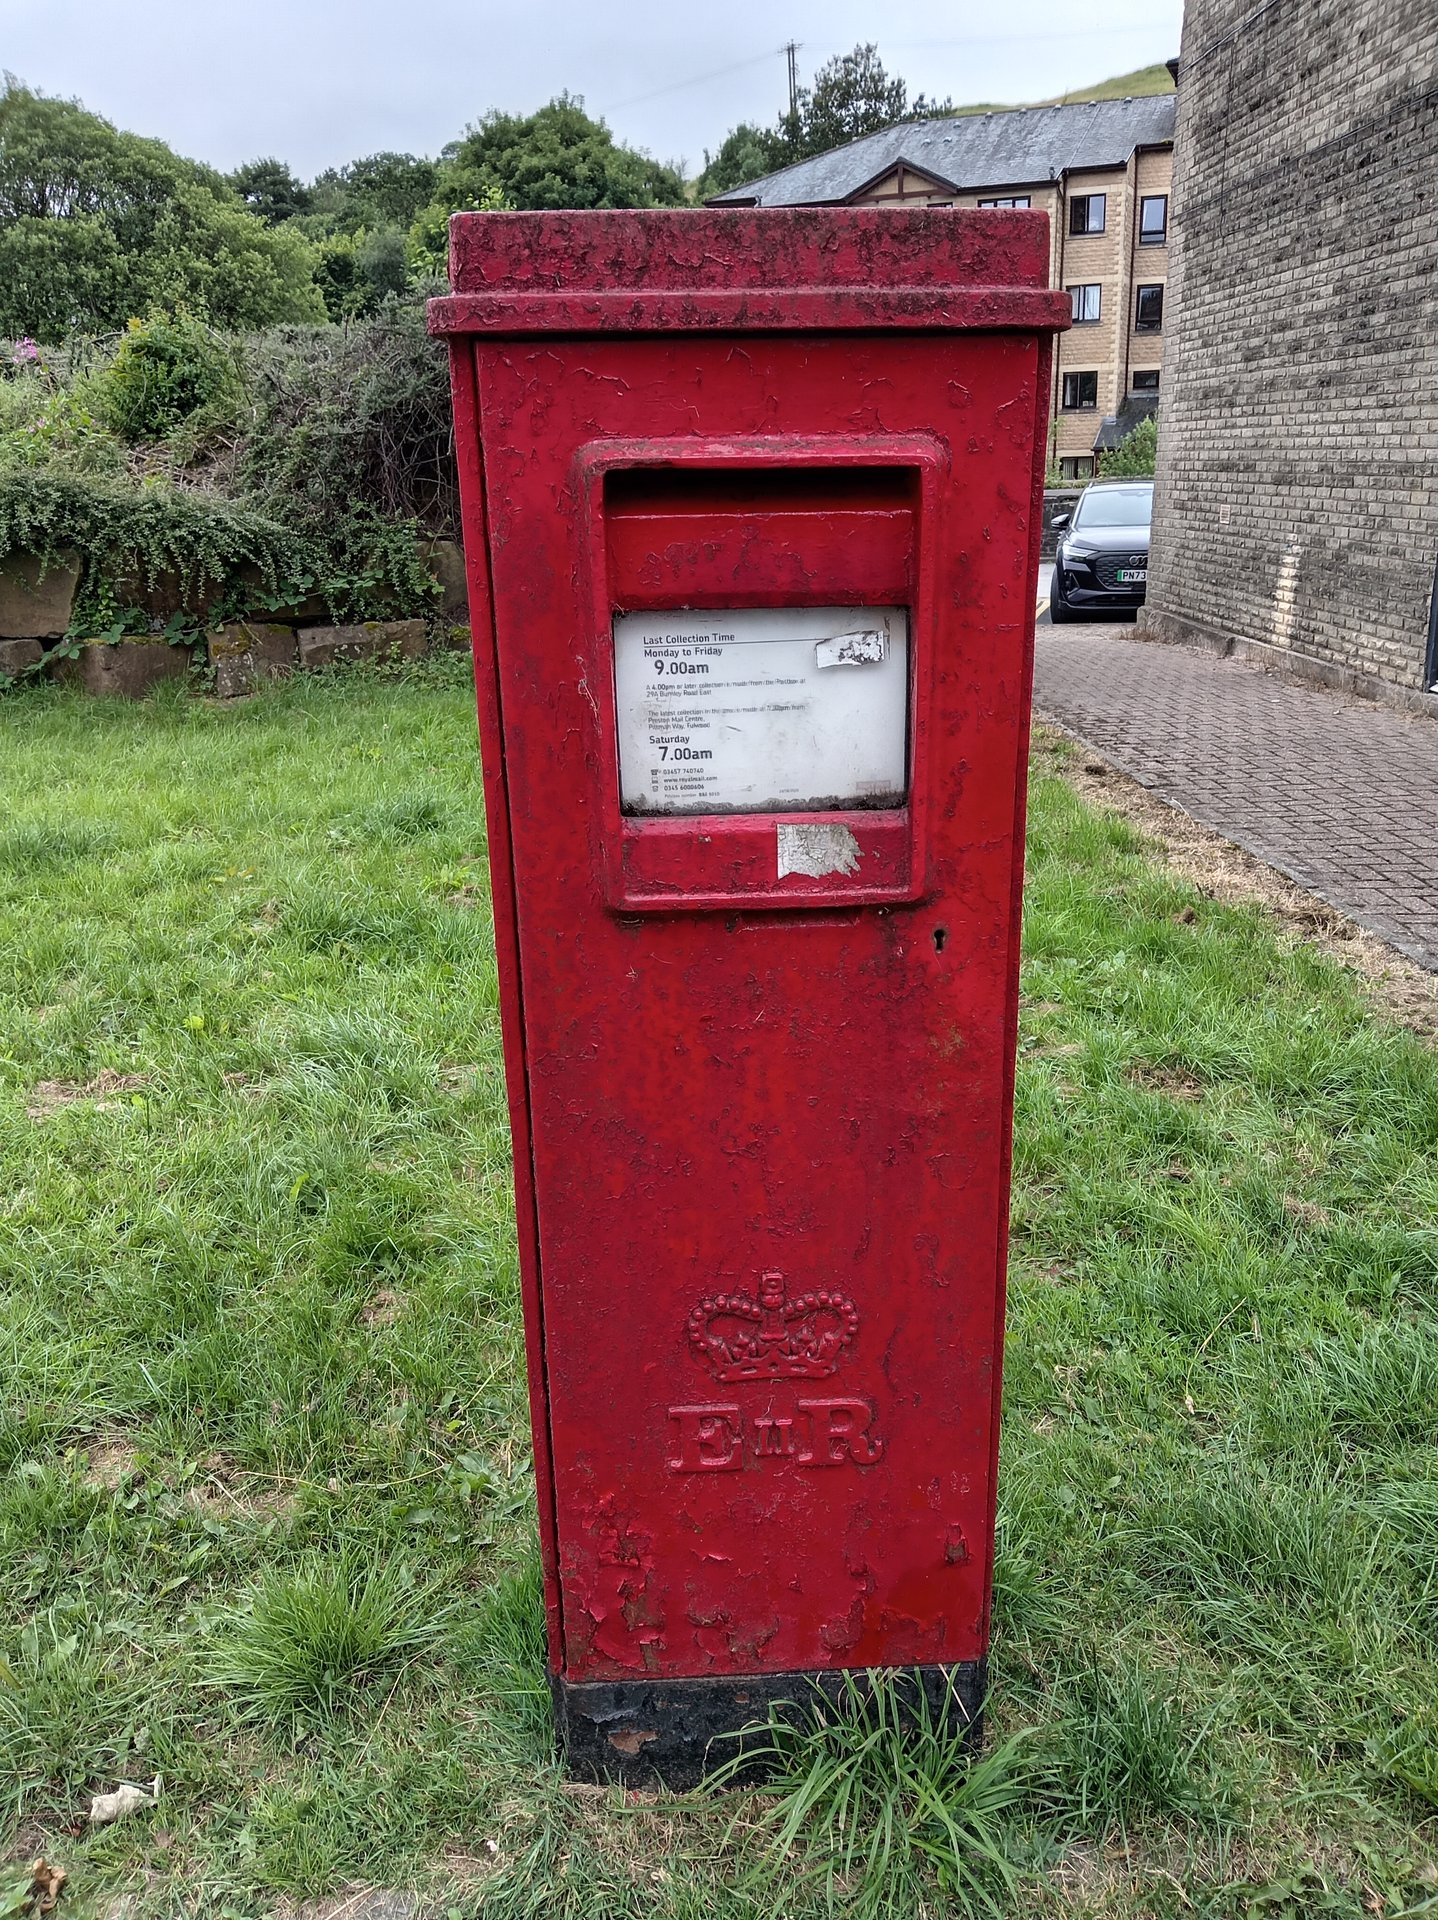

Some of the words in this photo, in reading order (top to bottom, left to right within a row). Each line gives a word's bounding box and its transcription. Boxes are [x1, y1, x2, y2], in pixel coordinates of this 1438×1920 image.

[1122, 571, 1147, 580] PN73
[643, 636, 663, 645] Last
[666, 633, 710, 644] Collection
[712, 632, 735, 642] Time
[644, 648, 680, 659] Monday
[682, 648, 692, 656] to
[695, 646, 723, 656] Friday
[654, 659, 710, 675] 9.00am
[652, 683, 676, 691] 4.00pm
[660, 690, 682, 698] Burnley
[677, 708, 703, 716] collection
[649, 735, 690, 744] Saturday
[658, 746, 713, 761] 7.00am
